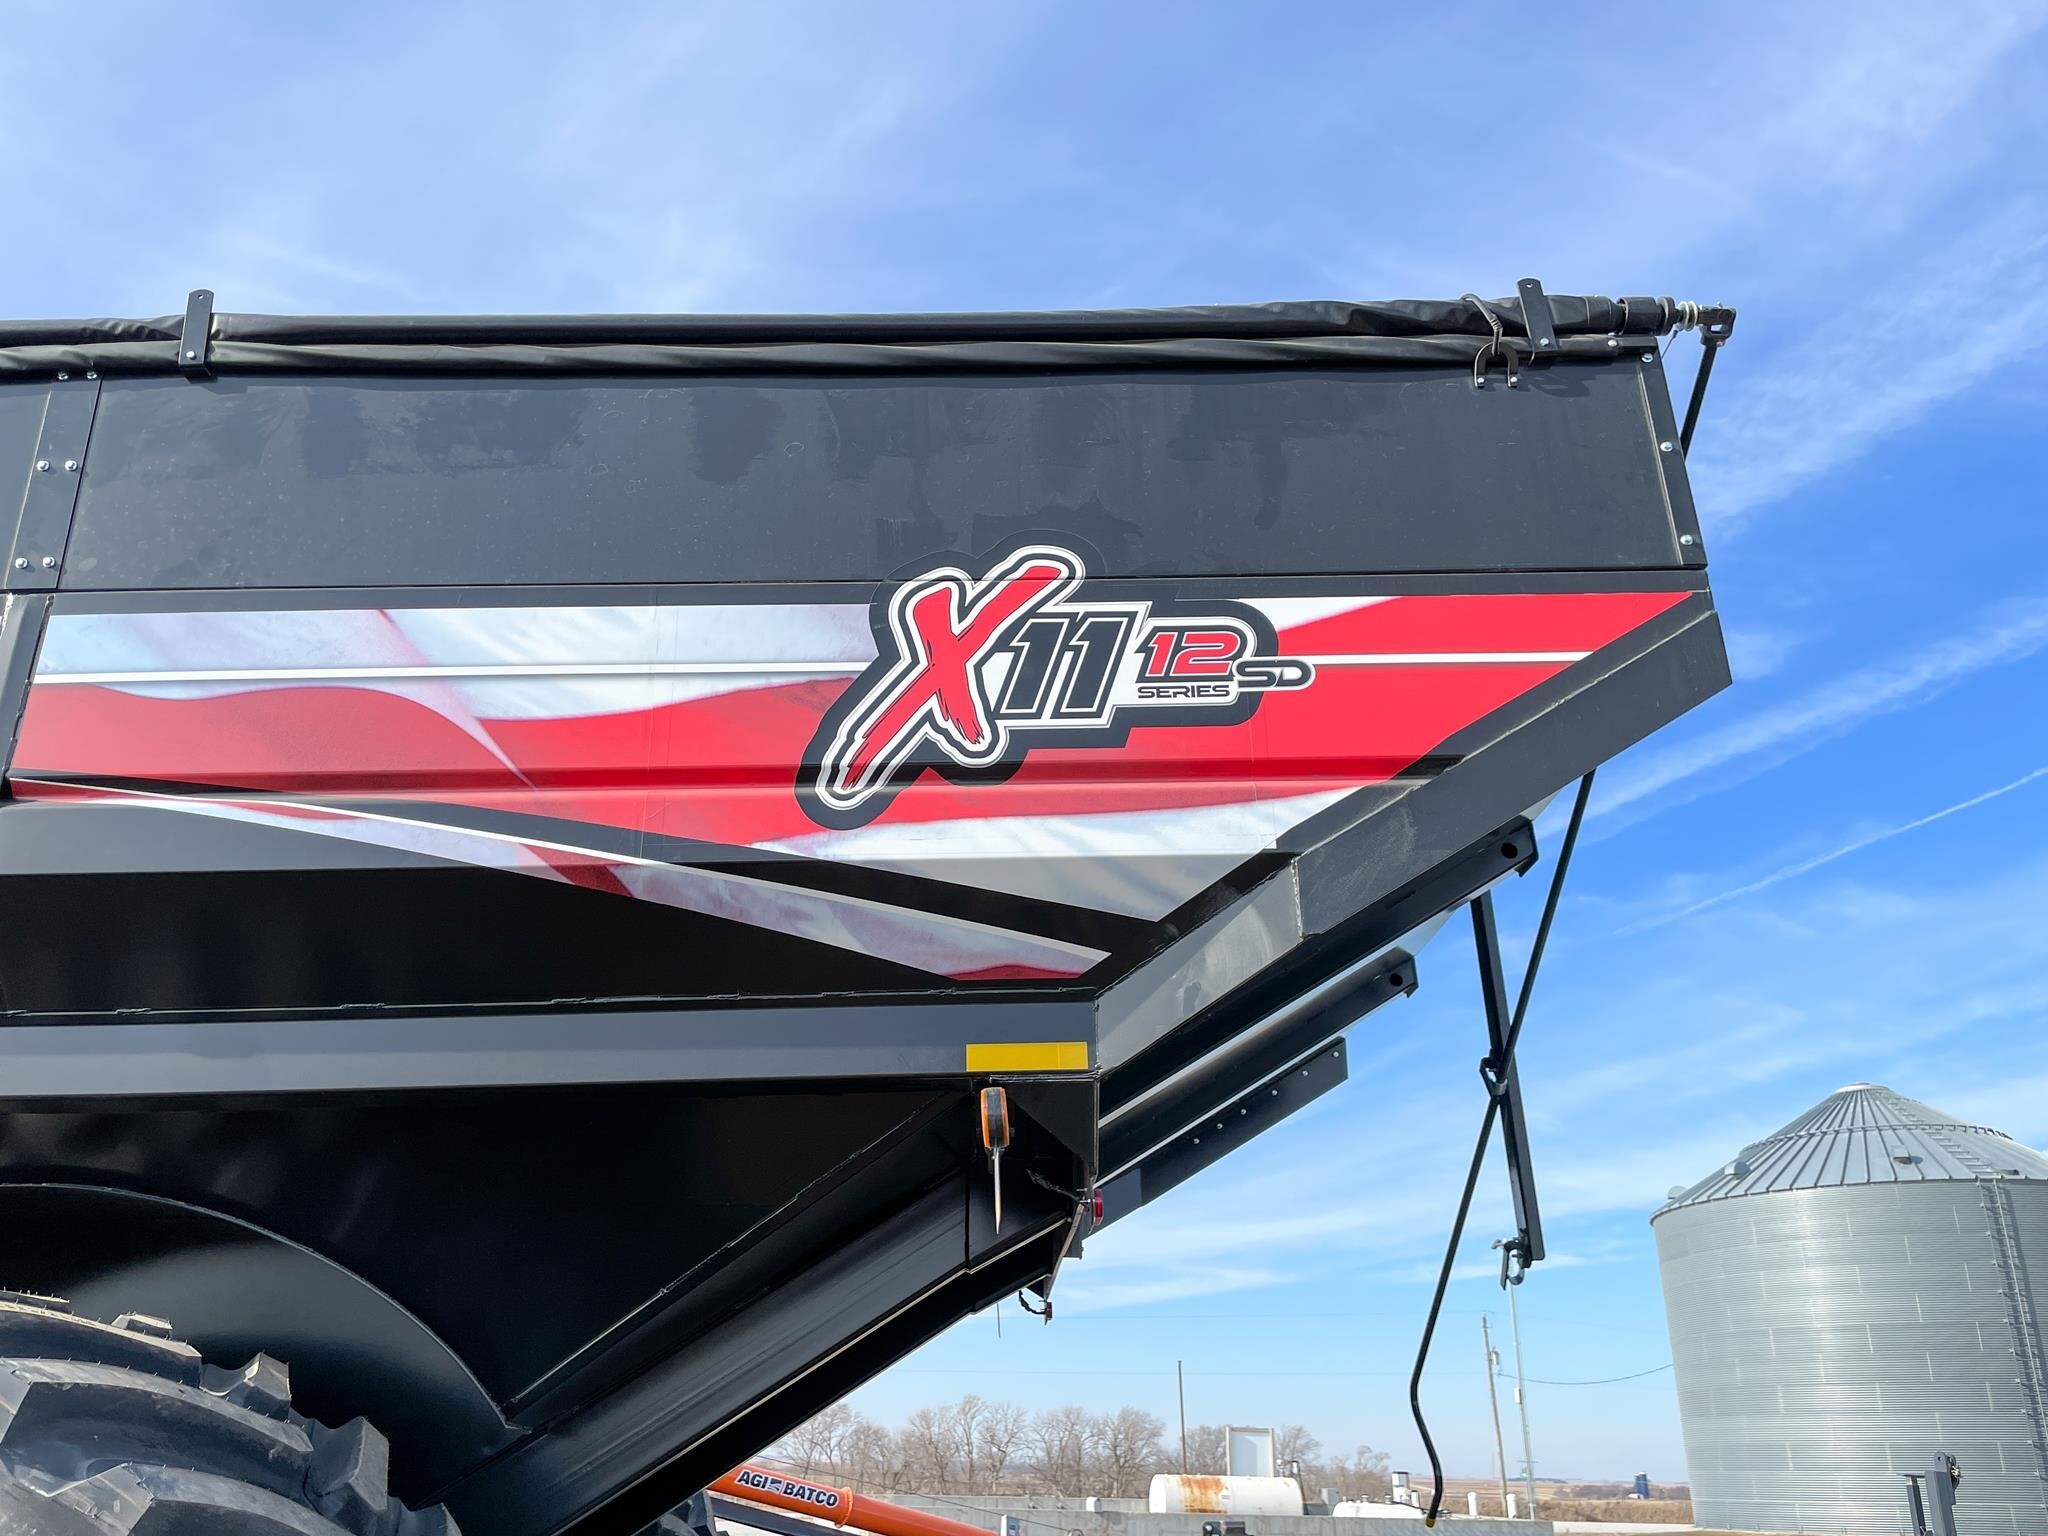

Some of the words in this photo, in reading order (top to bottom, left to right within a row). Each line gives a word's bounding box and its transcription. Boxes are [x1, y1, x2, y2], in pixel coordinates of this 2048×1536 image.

[1144, 630, 1241, 677] 12
[1235, 659, 1314, 688] SD
[1137, 684, 1231, 699] SERIES
[738, 1470, 768, 1489] AGI
[783, 1483, 838, 1507] BATCO
